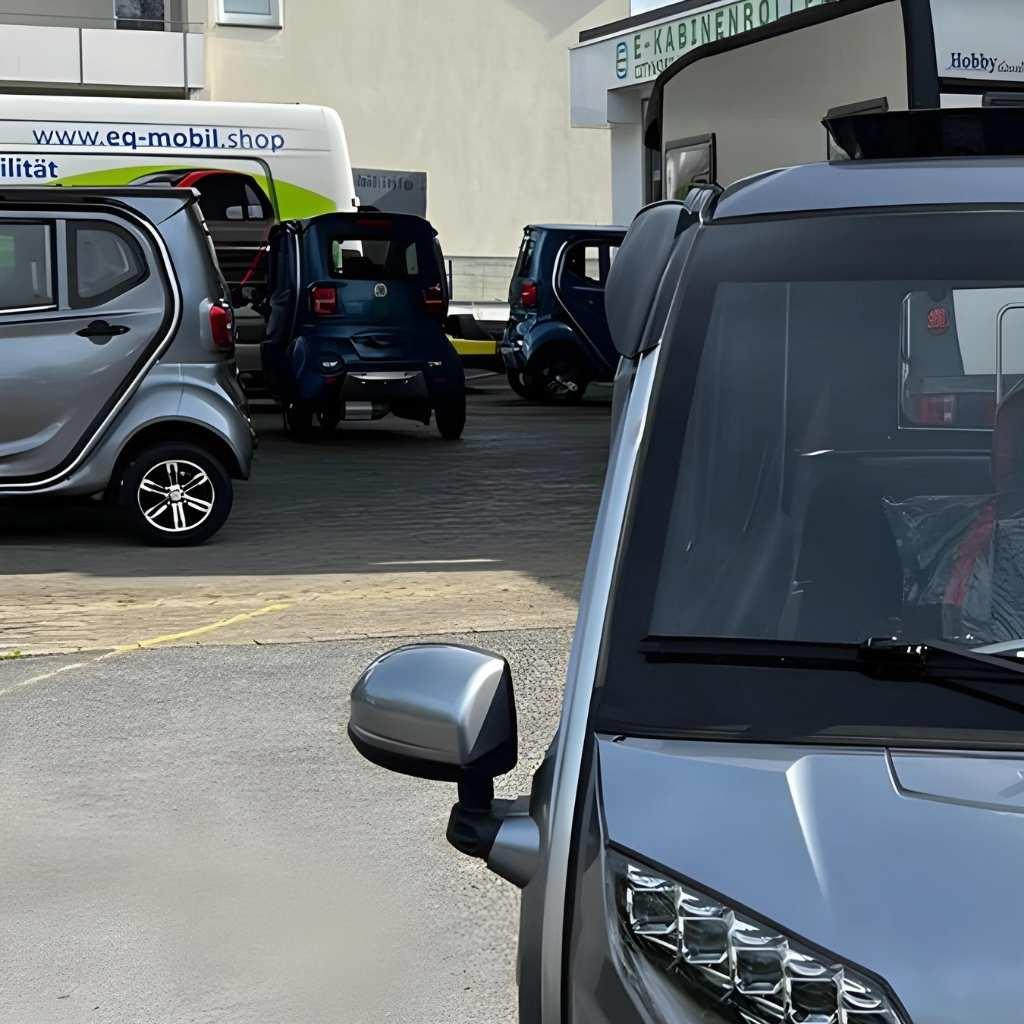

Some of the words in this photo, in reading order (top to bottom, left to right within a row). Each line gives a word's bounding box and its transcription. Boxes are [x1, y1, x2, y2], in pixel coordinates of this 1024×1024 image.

[950, 52, 998, 73] Hobby
[32, 127, 285, 152] www.eq-mobil.shop
[1, 157, 58, 178] ilität
